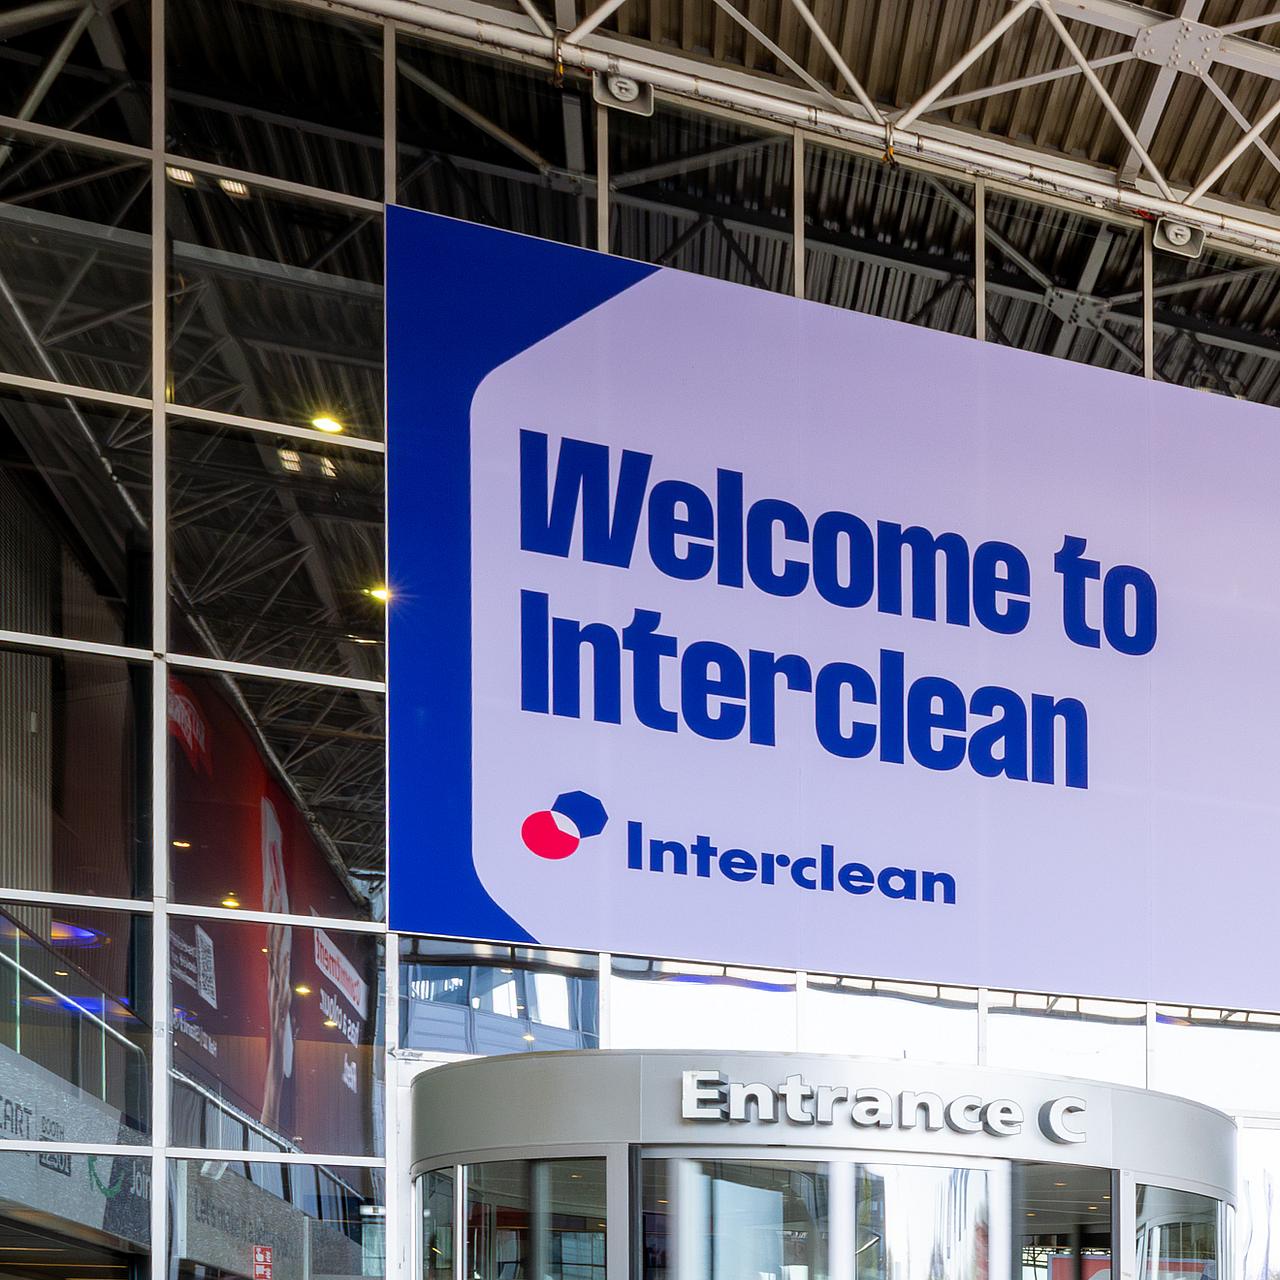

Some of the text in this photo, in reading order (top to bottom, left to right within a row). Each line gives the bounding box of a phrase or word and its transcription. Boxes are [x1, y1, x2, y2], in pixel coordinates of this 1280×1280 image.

[520, 430, 1157, 655] Welcome to
[521, 589, 1088, 789] Interclean
[627, 820, 956, 905] Interclean
[681, 1069, 1088, 1145] Entrance C
